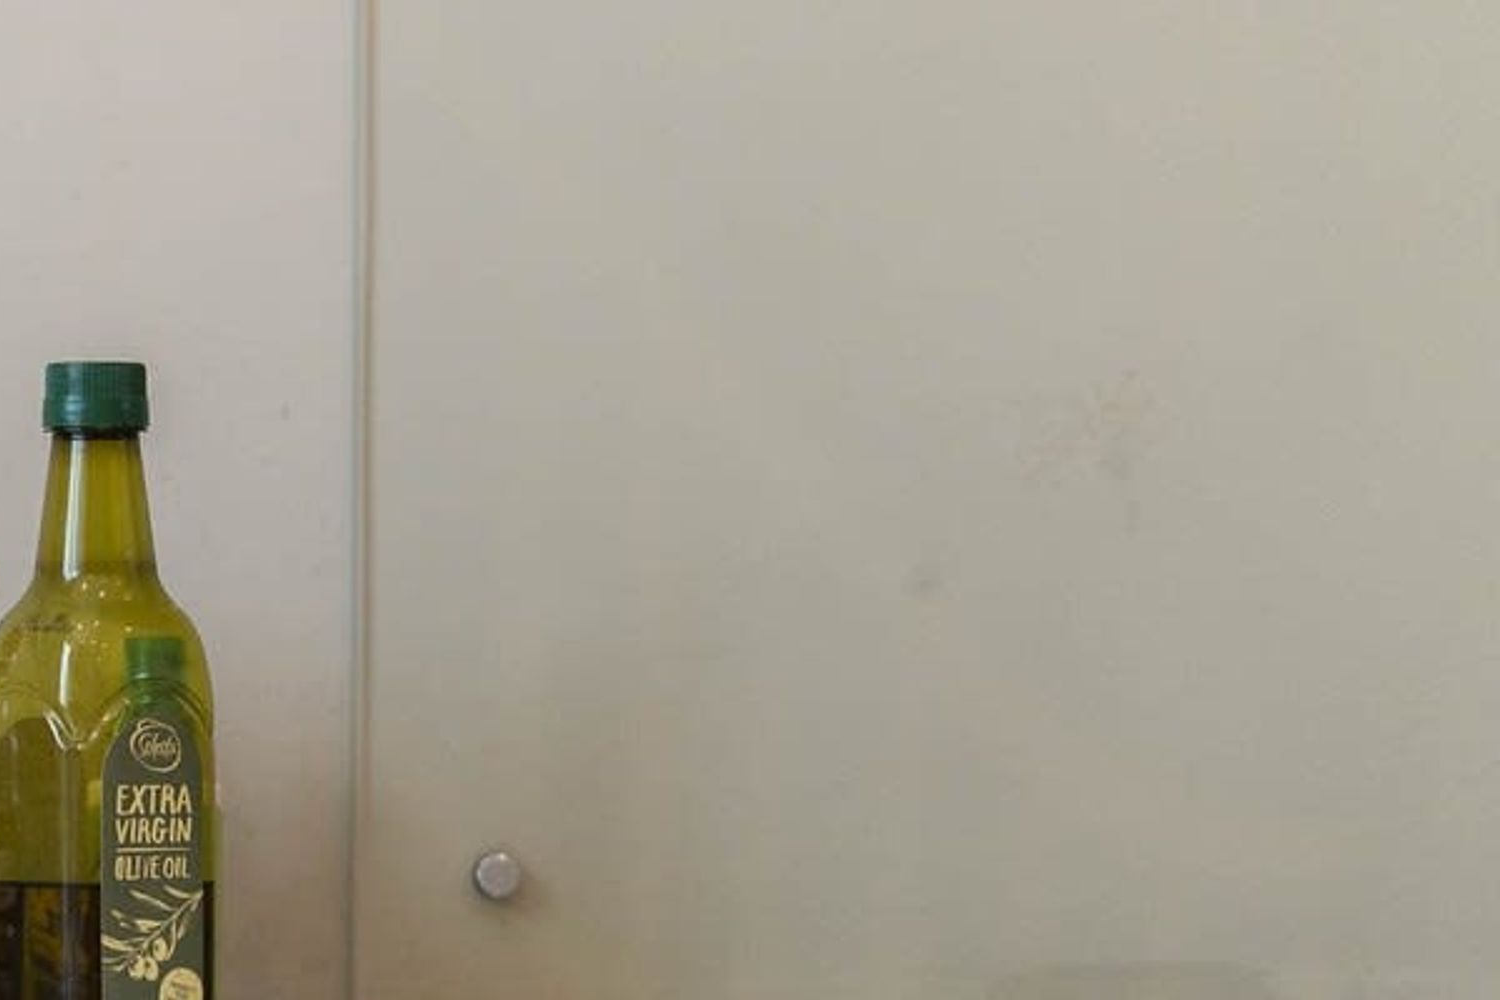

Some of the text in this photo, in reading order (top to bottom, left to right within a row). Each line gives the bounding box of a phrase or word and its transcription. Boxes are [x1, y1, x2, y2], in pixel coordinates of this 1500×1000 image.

[116, 784, 192, 816] EXTRA
[115, 817, 192, 845] VIRGIN
[114, 855, 191, 881] OLIVE OIL
